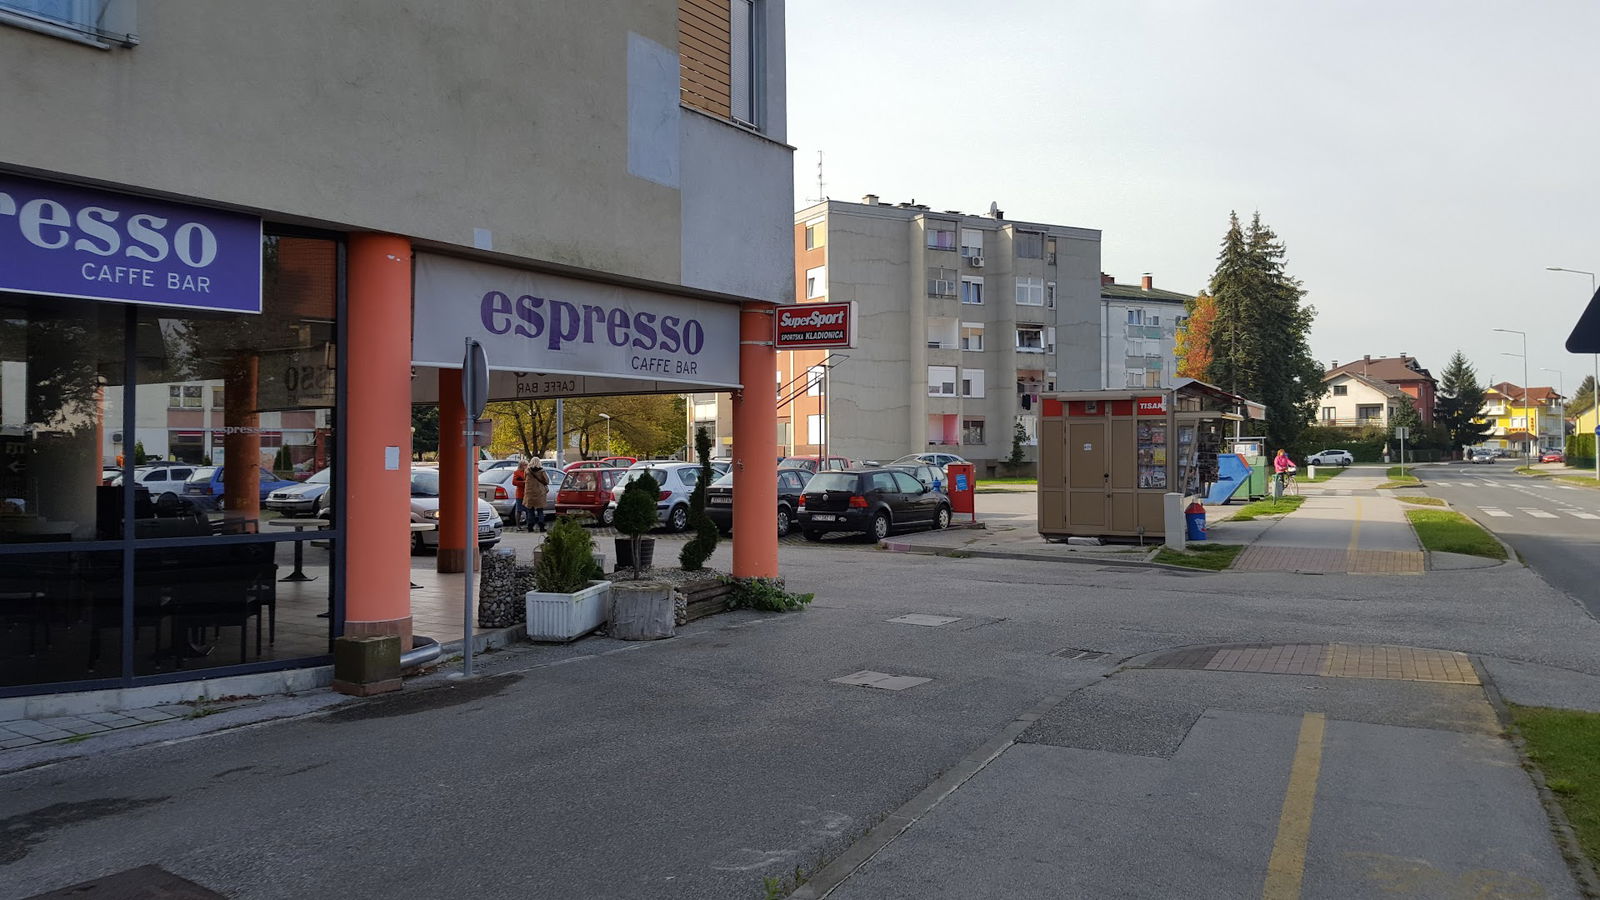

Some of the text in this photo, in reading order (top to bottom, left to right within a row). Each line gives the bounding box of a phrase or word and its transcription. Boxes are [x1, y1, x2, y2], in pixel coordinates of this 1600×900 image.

[82, 262, 211, 294] CAFFE BAR
[480, 290, 705, 356] espresso
[780, 311, 844, 327] SuperSport
[805, 331, 843, 340] KLADIONICA
[630, 355, 698, 375] CAFFE BAR
